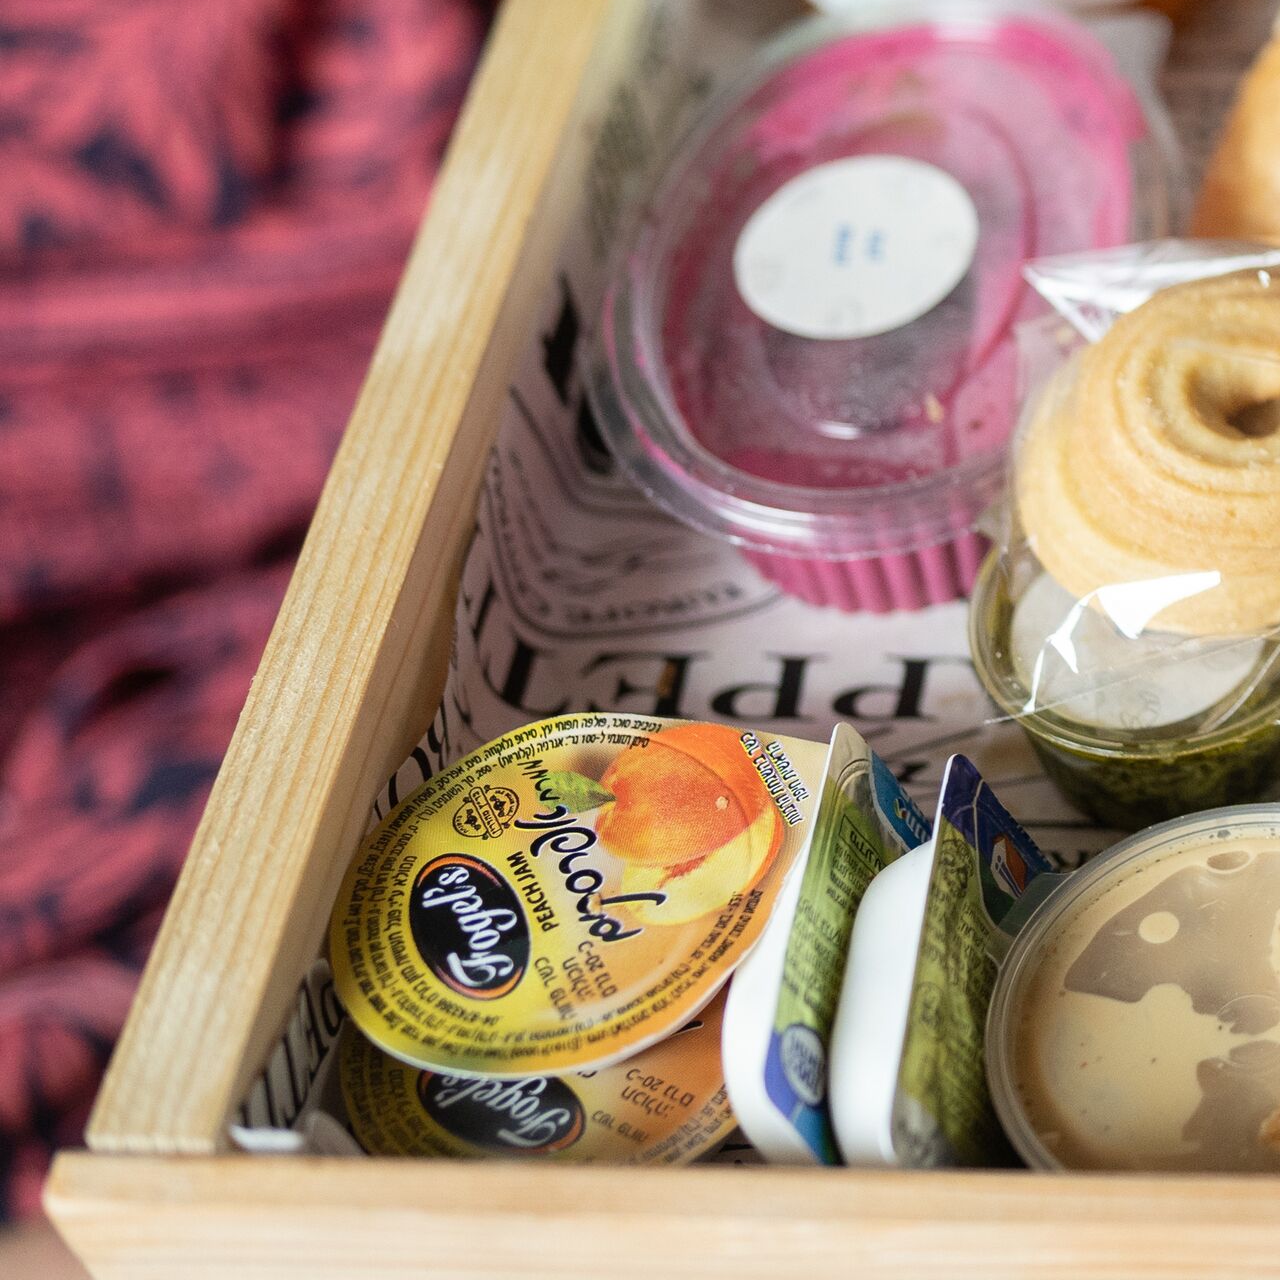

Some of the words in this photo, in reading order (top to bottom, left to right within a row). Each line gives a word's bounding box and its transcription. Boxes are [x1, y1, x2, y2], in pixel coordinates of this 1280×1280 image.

[739, 730, 760, 756] כשר
[752, 753, 784, 797] בהשגחת
[774, 793, 803, 827] הרבנות
[764, 740, 797, 783] הראשית
[787, 778, 809, 804] חיפה
[506, 850, 532, 883] JAM
[422, 867, 517, 989] Fogel's
[521, 881, 559, 932] PEACH
[533, 955, 556, 987] כשר
[576, 938, 604, 972] כ-20
[593, 971, 617, 998] גרם
[625, 1066, 664, 1093] כ-20
[662, 1083, 695, 1108] גרם
